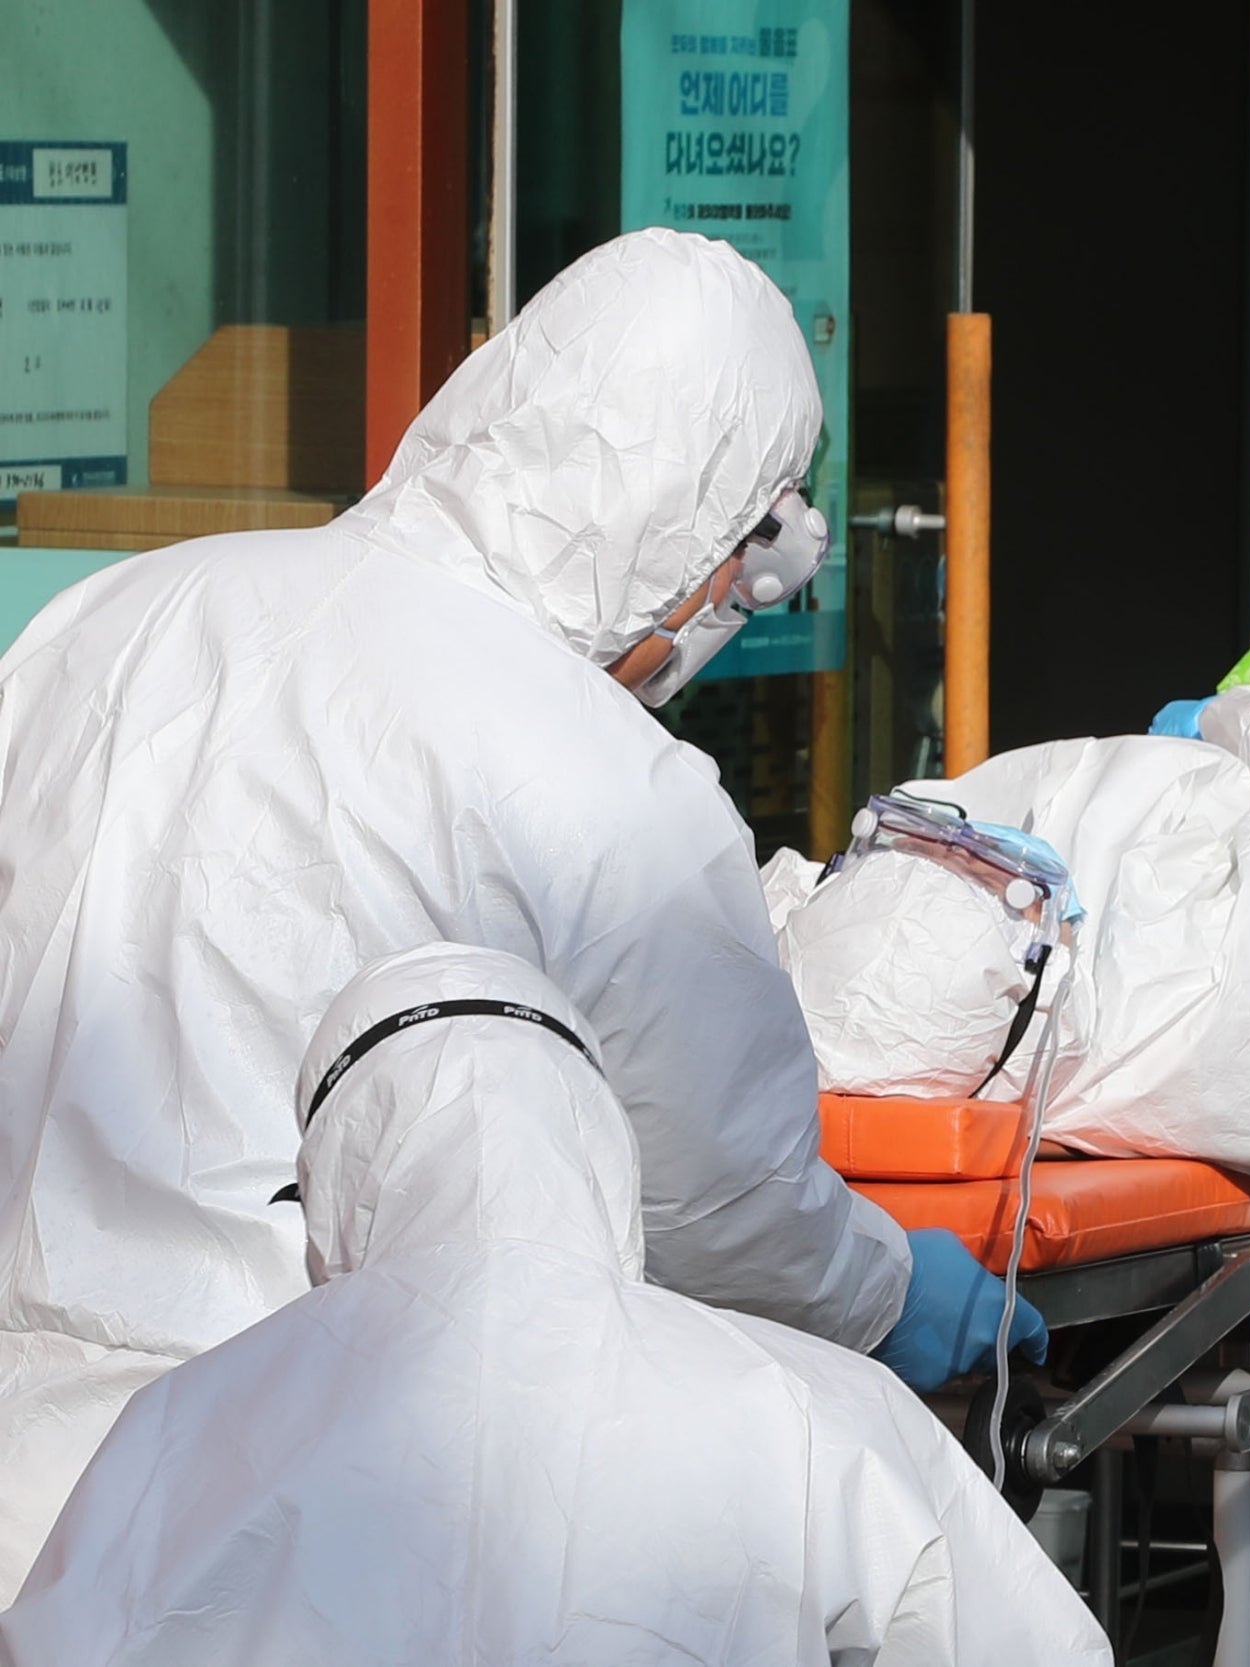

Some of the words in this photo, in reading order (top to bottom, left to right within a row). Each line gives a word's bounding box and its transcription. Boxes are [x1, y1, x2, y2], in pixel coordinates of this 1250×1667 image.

[680, 71, 724, 117] 언제
[728, 72, 789, 117] 어디를
[665, 131, 800, 177] 다녀오셨나요?
